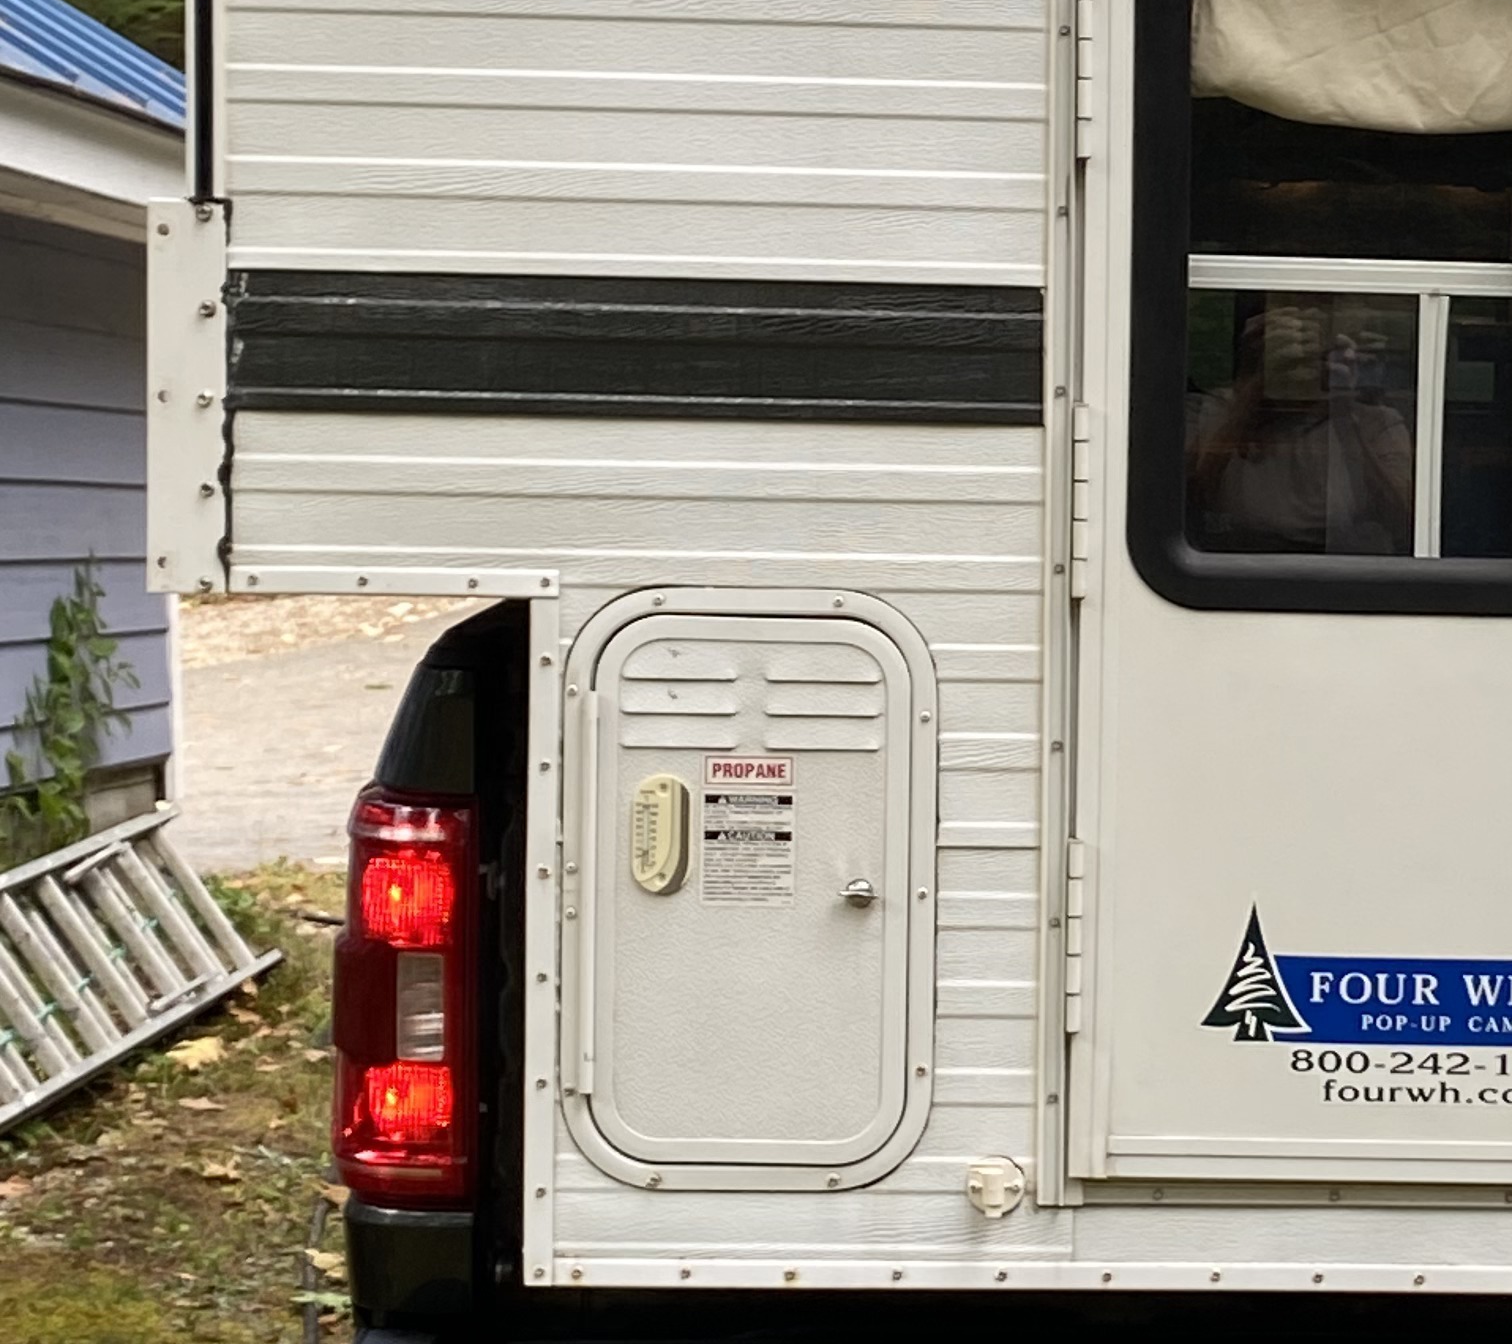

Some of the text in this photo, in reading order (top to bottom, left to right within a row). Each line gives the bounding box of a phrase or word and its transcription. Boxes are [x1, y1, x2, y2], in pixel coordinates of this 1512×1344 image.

[711, 763, 787, 779] PROPANE
[728, 831, 775, 841] CAUTION
[1309, 971, 1440, 1007] FOUR
[1360, 1013, 1452, 1034] POP-UP
